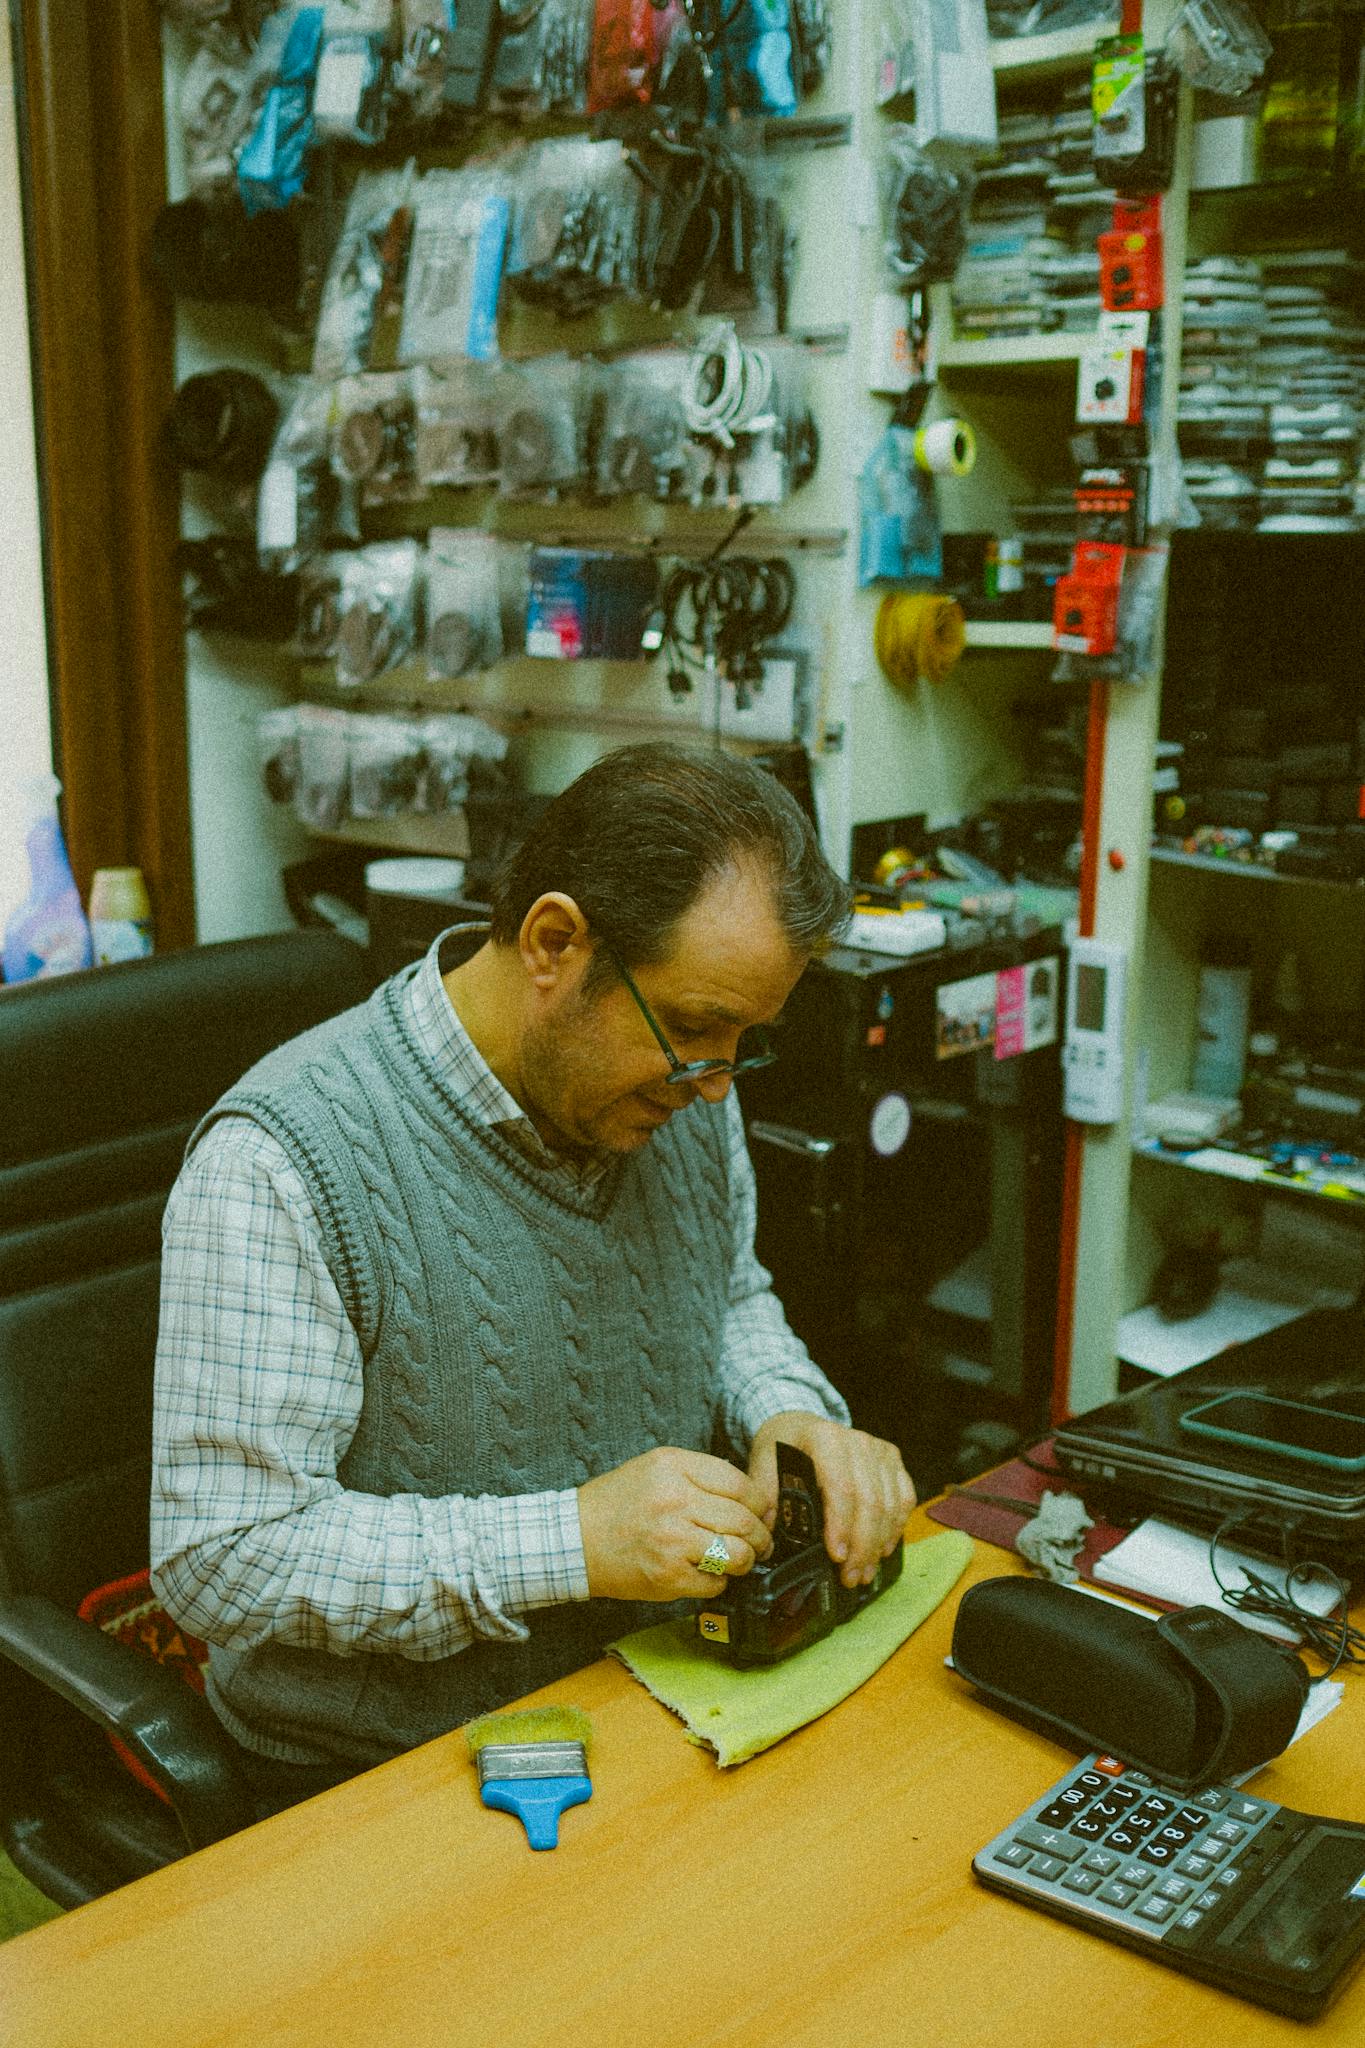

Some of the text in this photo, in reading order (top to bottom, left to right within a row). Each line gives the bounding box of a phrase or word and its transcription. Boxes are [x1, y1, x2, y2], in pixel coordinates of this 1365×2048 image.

[1081, 1775, 1101, 1786] 0
[1061, 1789, 1085, 1804] 00
[1112, 1788, 1133, 1798] 1
[1200, 1789, 1222, 1805] AC
[1094, 1802, 1117, 1815] 2
[1145, 1798, 1166, 1811] 4
[1129, 1815, 1152, 1828] 5
[1182, 1810, 1204, 1824] 7
[1077, 1819, 1099, 1832] 3
[1216, 1822, 1240, 1838] MC
[1111, 1832, 1132, 1844] 6
[1163, 1827, 1186, 1840] 8
[1147, 1845, 1168, 1857] 9
